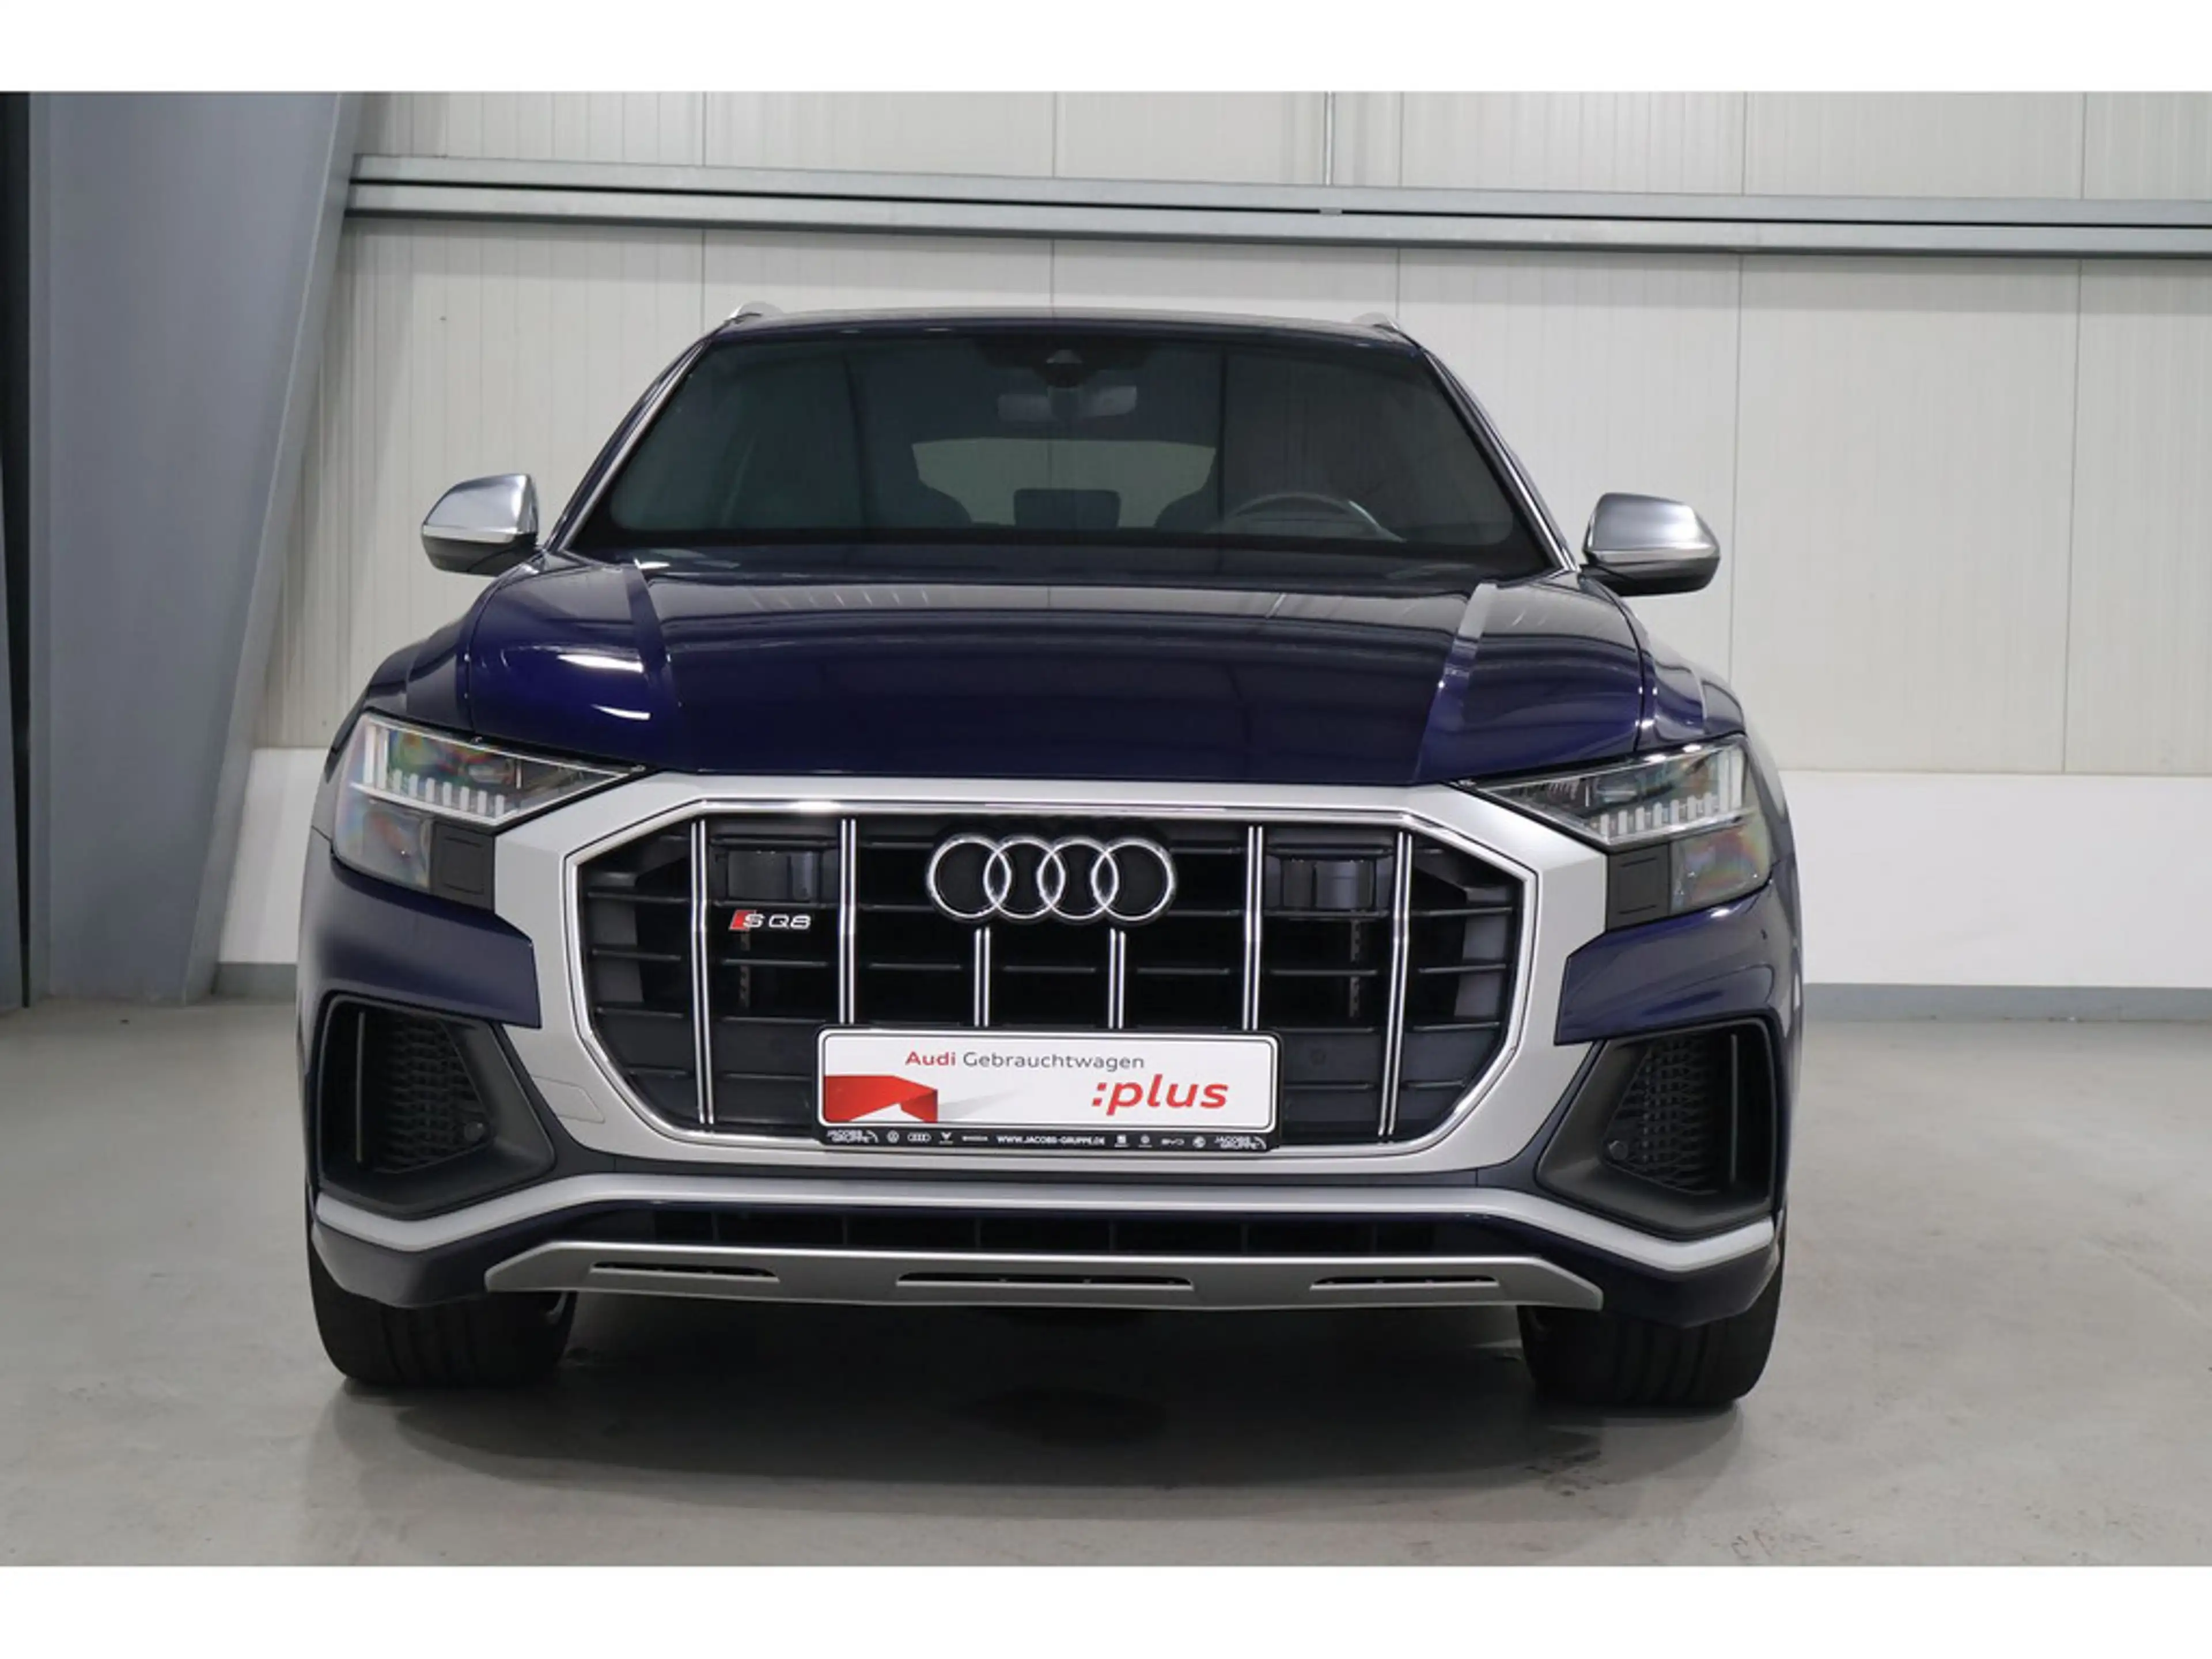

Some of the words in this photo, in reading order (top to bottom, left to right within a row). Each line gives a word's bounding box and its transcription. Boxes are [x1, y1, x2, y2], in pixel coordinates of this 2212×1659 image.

[743, 912, 811, 930] SQ8
[905, 1051, 956, 1066] Audi
[963, 1051, 1145, 1073] Gebrauchtwagen
[1092, 1073, 1229, 1116] :plus
